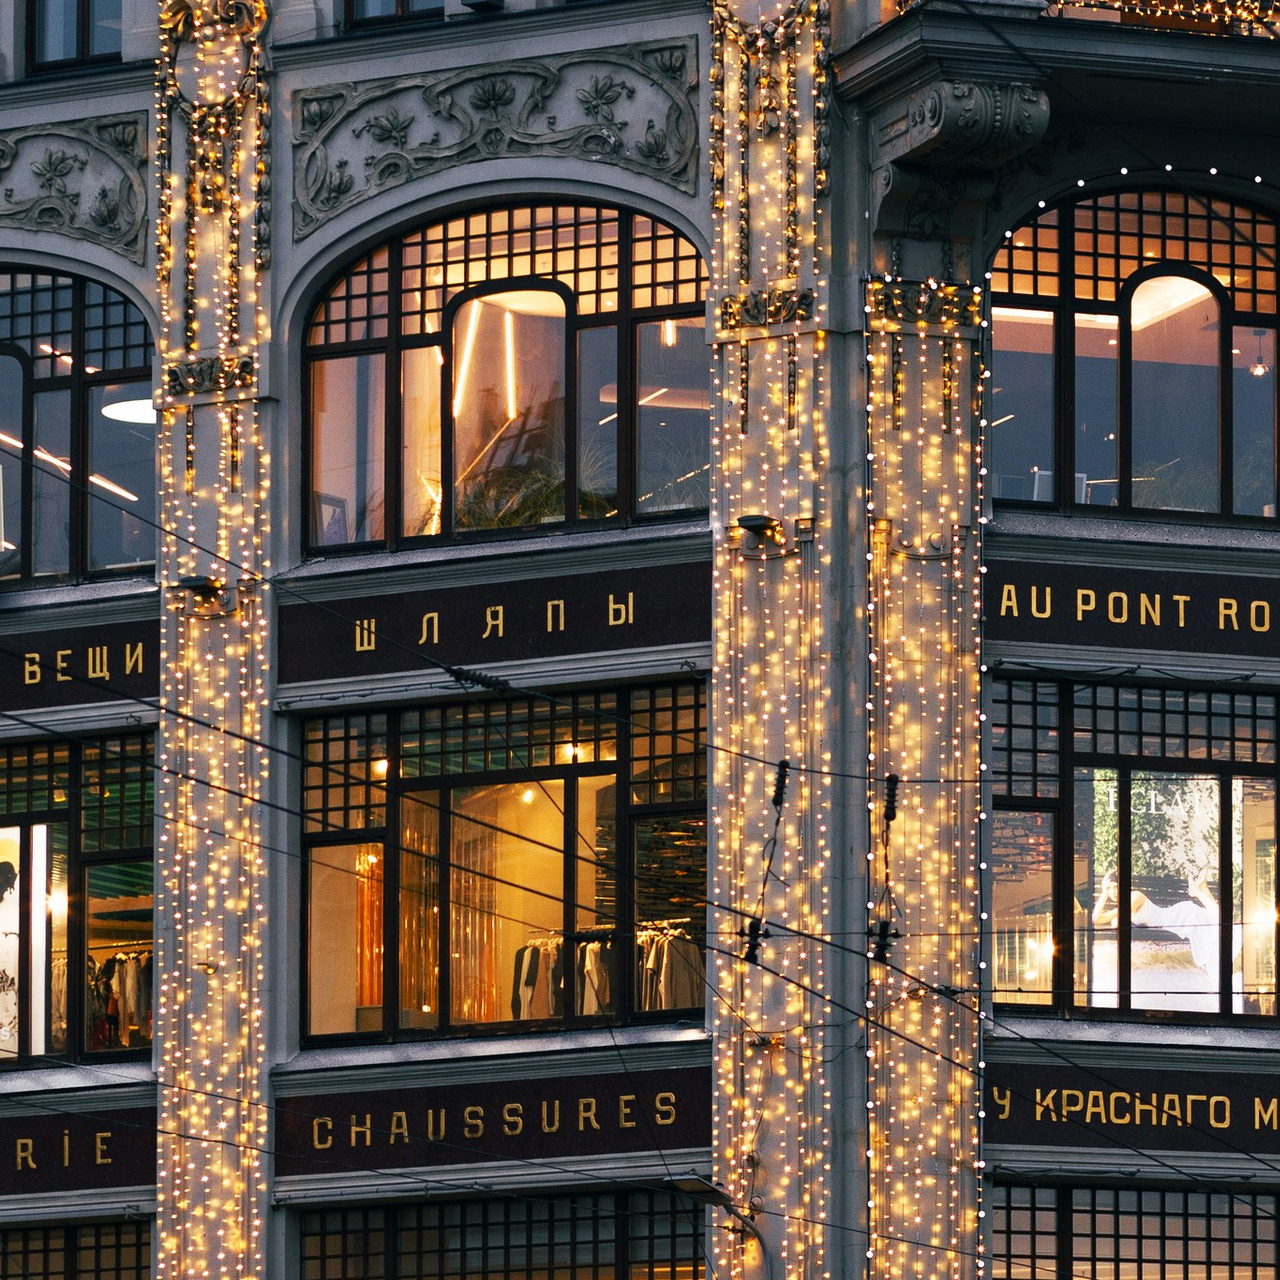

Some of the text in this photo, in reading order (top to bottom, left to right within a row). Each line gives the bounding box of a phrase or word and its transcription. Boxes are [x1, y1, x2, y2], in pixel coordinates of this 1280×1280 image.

[355, 591, 634, 652] ШЛЯПЫ
[1000, 584, 1052, 619] AU
[1076, 588, 1191, 628] PONT
[24, 642, 143, 686] ВЕЩИ
[312, 1092, 676, 1150] CHAUSSURES
[992, 1086, 1011, 1120] У
[1035, 1088, 1231, 1129] КРАСНАГО
